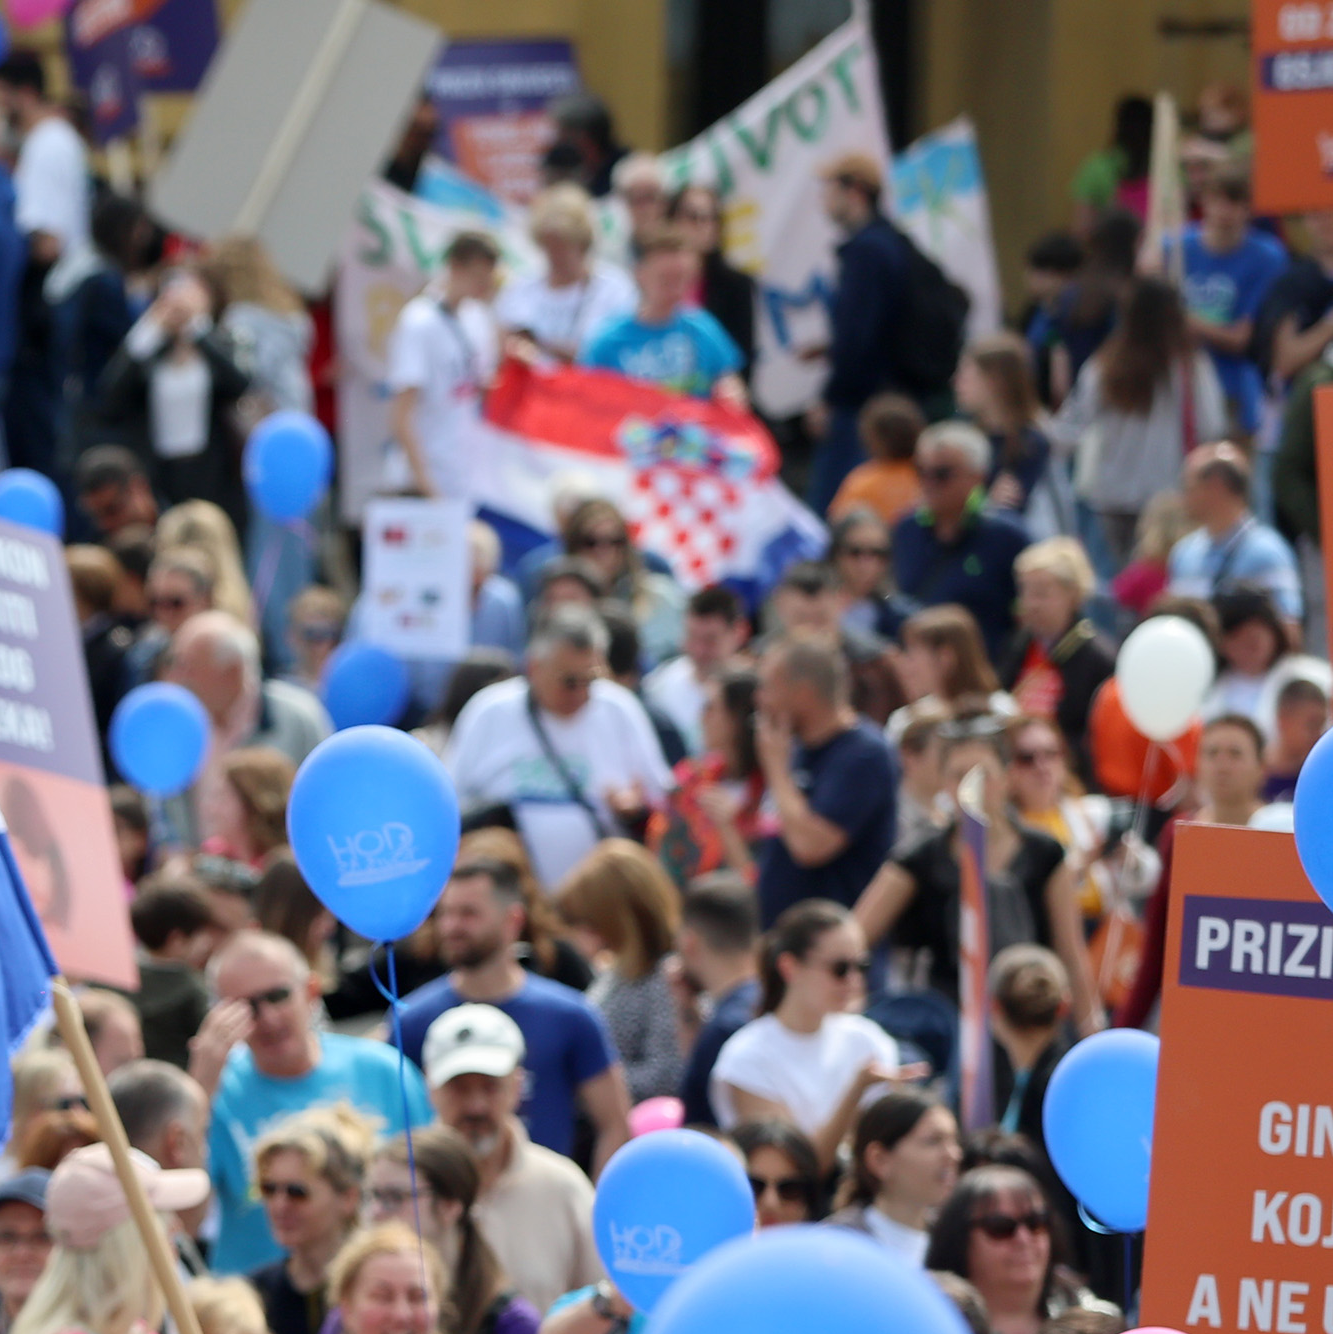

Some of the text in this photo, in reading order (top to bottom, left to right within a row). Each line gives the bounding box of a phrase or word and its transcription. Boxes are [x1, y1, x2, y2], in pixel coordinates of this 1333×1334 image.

[1195, 915, 1333, 980] PRIZI
[1185, 1273, 1310, 1334] A NE
